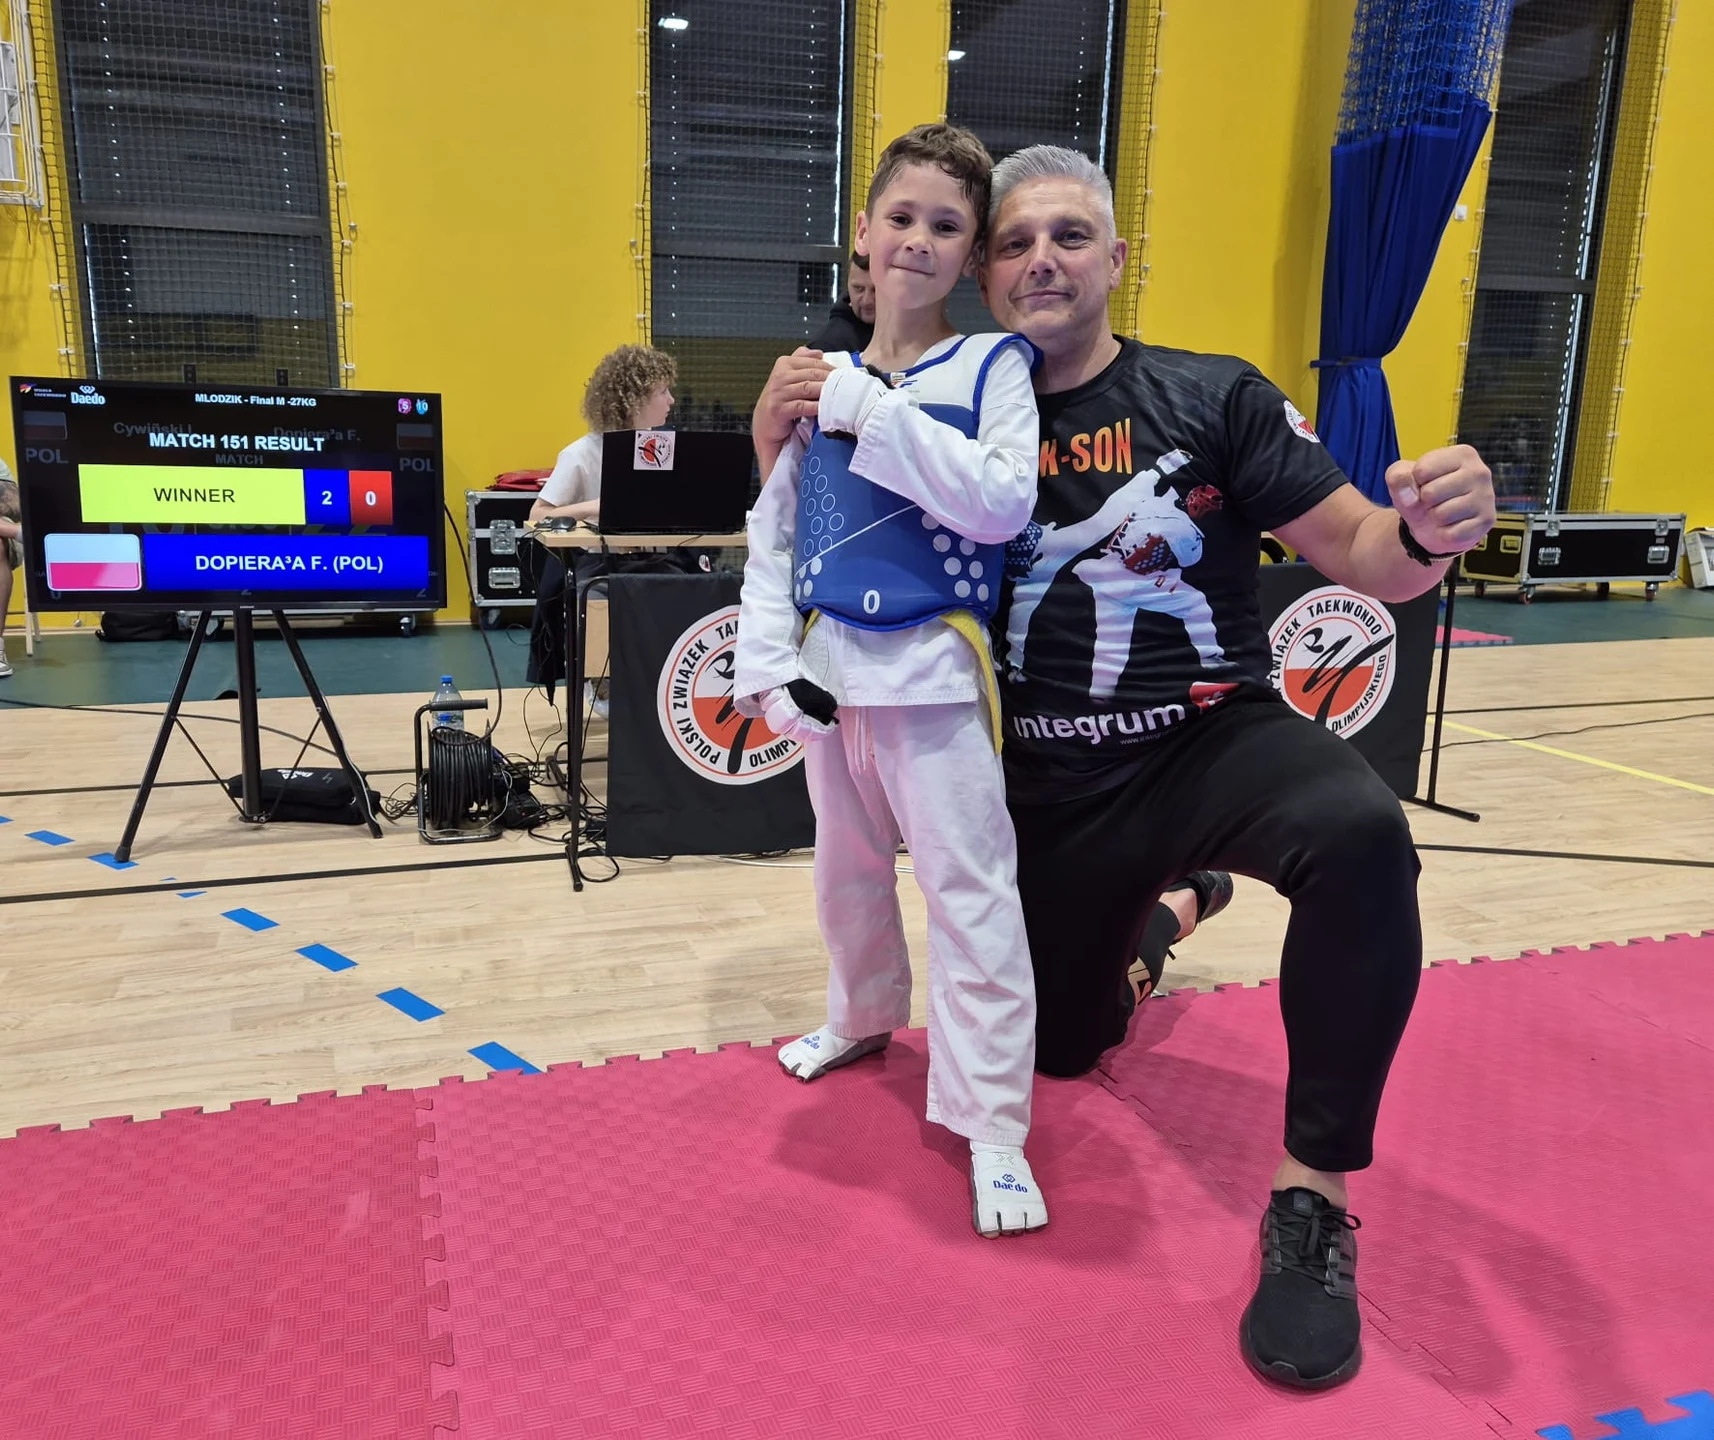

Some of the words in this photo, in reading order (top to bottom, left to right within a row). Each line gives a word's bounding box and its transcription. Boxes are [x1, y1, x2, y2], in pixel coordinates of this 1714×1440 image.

[70, 392, 106, 405] Daedo
[195, 394, 242, 404] MLODZIK
[250, 396, 273, 405] Final
[276, 397, 285, 406] M
[287, 398, 317, 407] -27KG
[150, 433, 215, 448] MATCH
[220, 435, 249, 449] 151
[254, 436, 325, 451] RESULT
[26, 448, 69, 464] POL
[215, 454, 263, 465] MATCH
[400, 458, 434, 472] POL
[154, 488, 236, 503] WINNER
[321, 491, 333, 505] 2
[365, 491, 377, 506] 0
[311, 556, 328, 571] F.
[333, 556, 384, 574] (POL)
[863, 589, 881, 614] 0
[1307, 599, 1382, 635] TAEKWONDO
[1269, 617, 1301, 680] ZWIĄZEK
[673, 638, 710, 710] ZWIĄZEK
[1331, 654, 1387, 733] OLIMPIJSKIEGO
[677, 718, 721, 765] POLSKI
